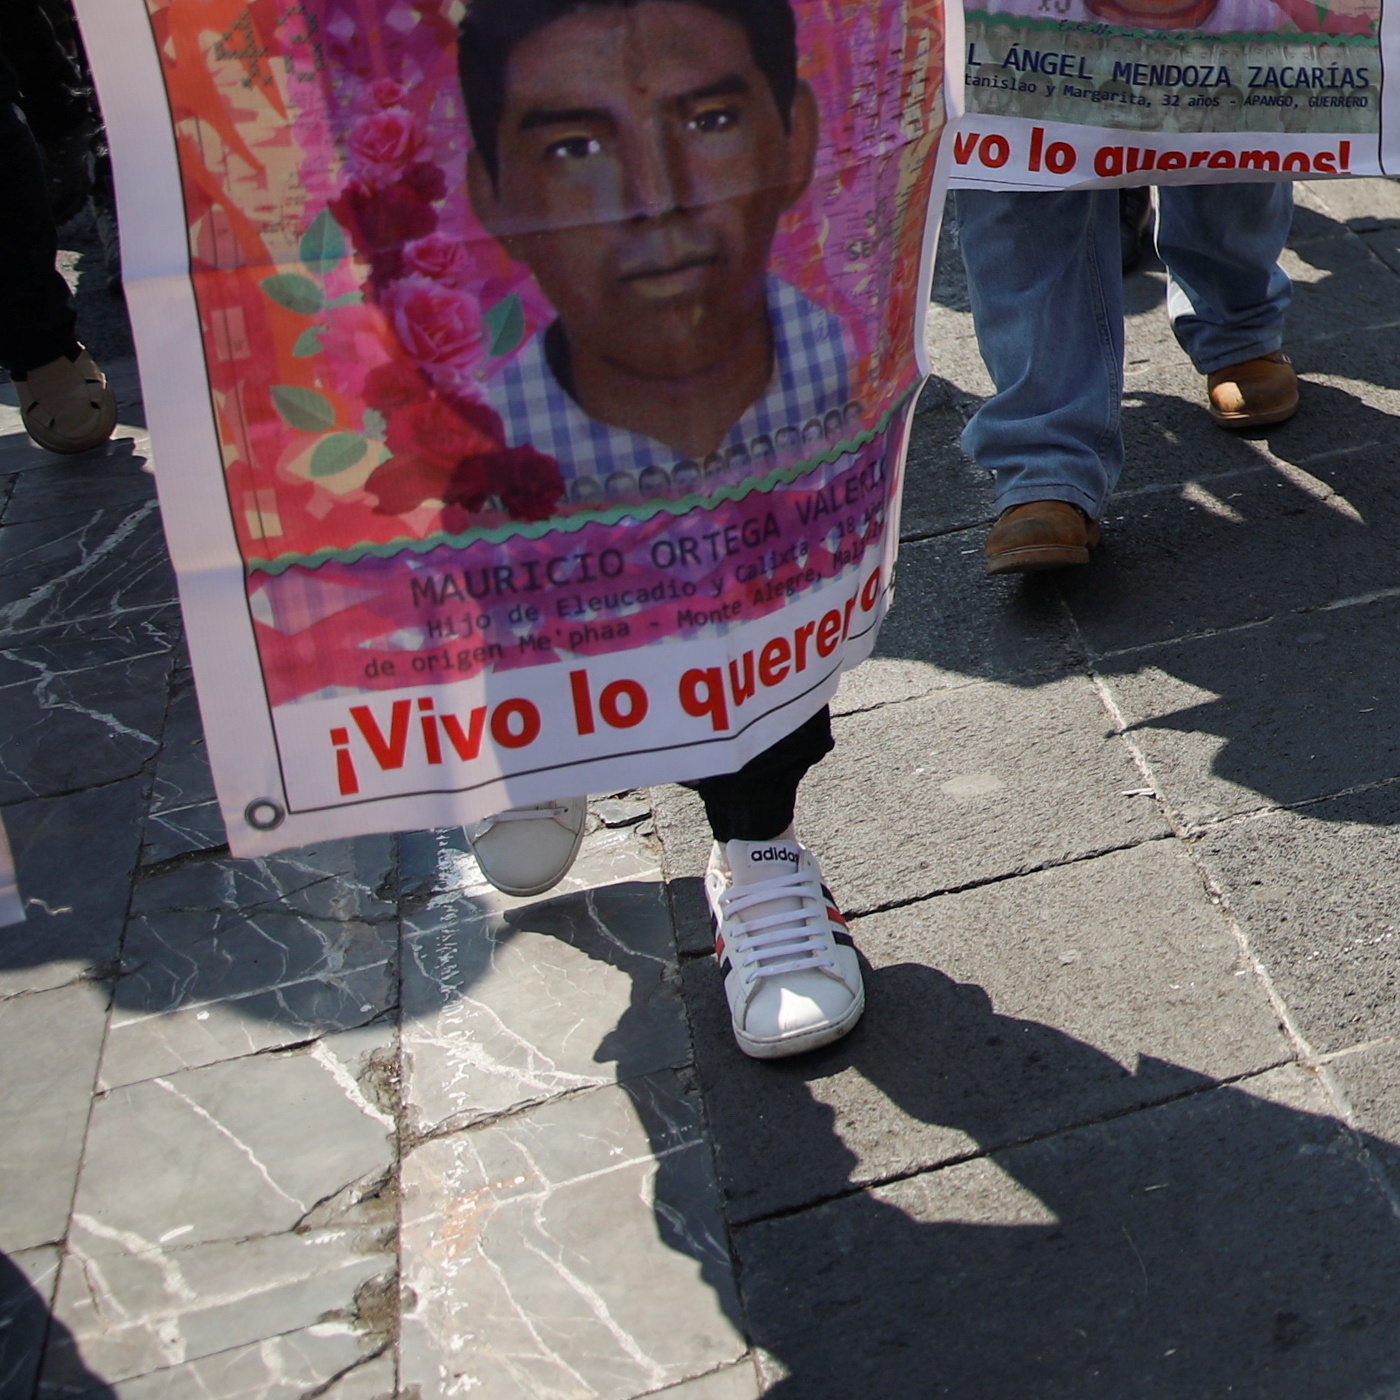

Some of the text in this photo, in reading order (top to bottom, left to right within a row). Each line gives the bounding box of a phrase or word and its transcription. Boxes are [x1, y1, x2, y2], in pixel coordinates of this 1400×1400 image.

[965, 73, 1037, 94] tanislao
[1045, 84, 1056, 99] y
[1063, 84, 1152, 108] Margarita,
[1162, 94, 1180, 107] 32
[1188, 94, 1220, 107] años
[1244, 95, 1299, 110] APANGO,
[1308, 95, 1368, 109] GUERRERO
[1002, 42, 1093, 80] ÁNGEL
[1112, 61, 1231, 89] MENDOZA
[1247, 62, 1370, 90] ZACARÍAS
[953, 132, 1009, 169] vo
[1029, 128, 1077, 175] lo
[410, 548, 625, 608] MAURICIO
[651, 511, 782, 570] ORTEGA
[427, 613, 491, 640] Hijo
[508, 604, 540, 625] de
[556, 580, 697, 619] Eleucadio
[711, 575, 724, 598] y
[735, 543, 809, 585] Calixta
[837, 517, 856, 540] 18
[364, 659, 396, 680] de
[411, 641, 505, 672] origen
[519, 619, 631, 655] Me'phaa
[677, 599, 742, 629] Monte
[752, 569, 823, 606] Alegre,
[330, 695, 542, 797] ¡Vivo
[570, 667, 649, 737] lo
